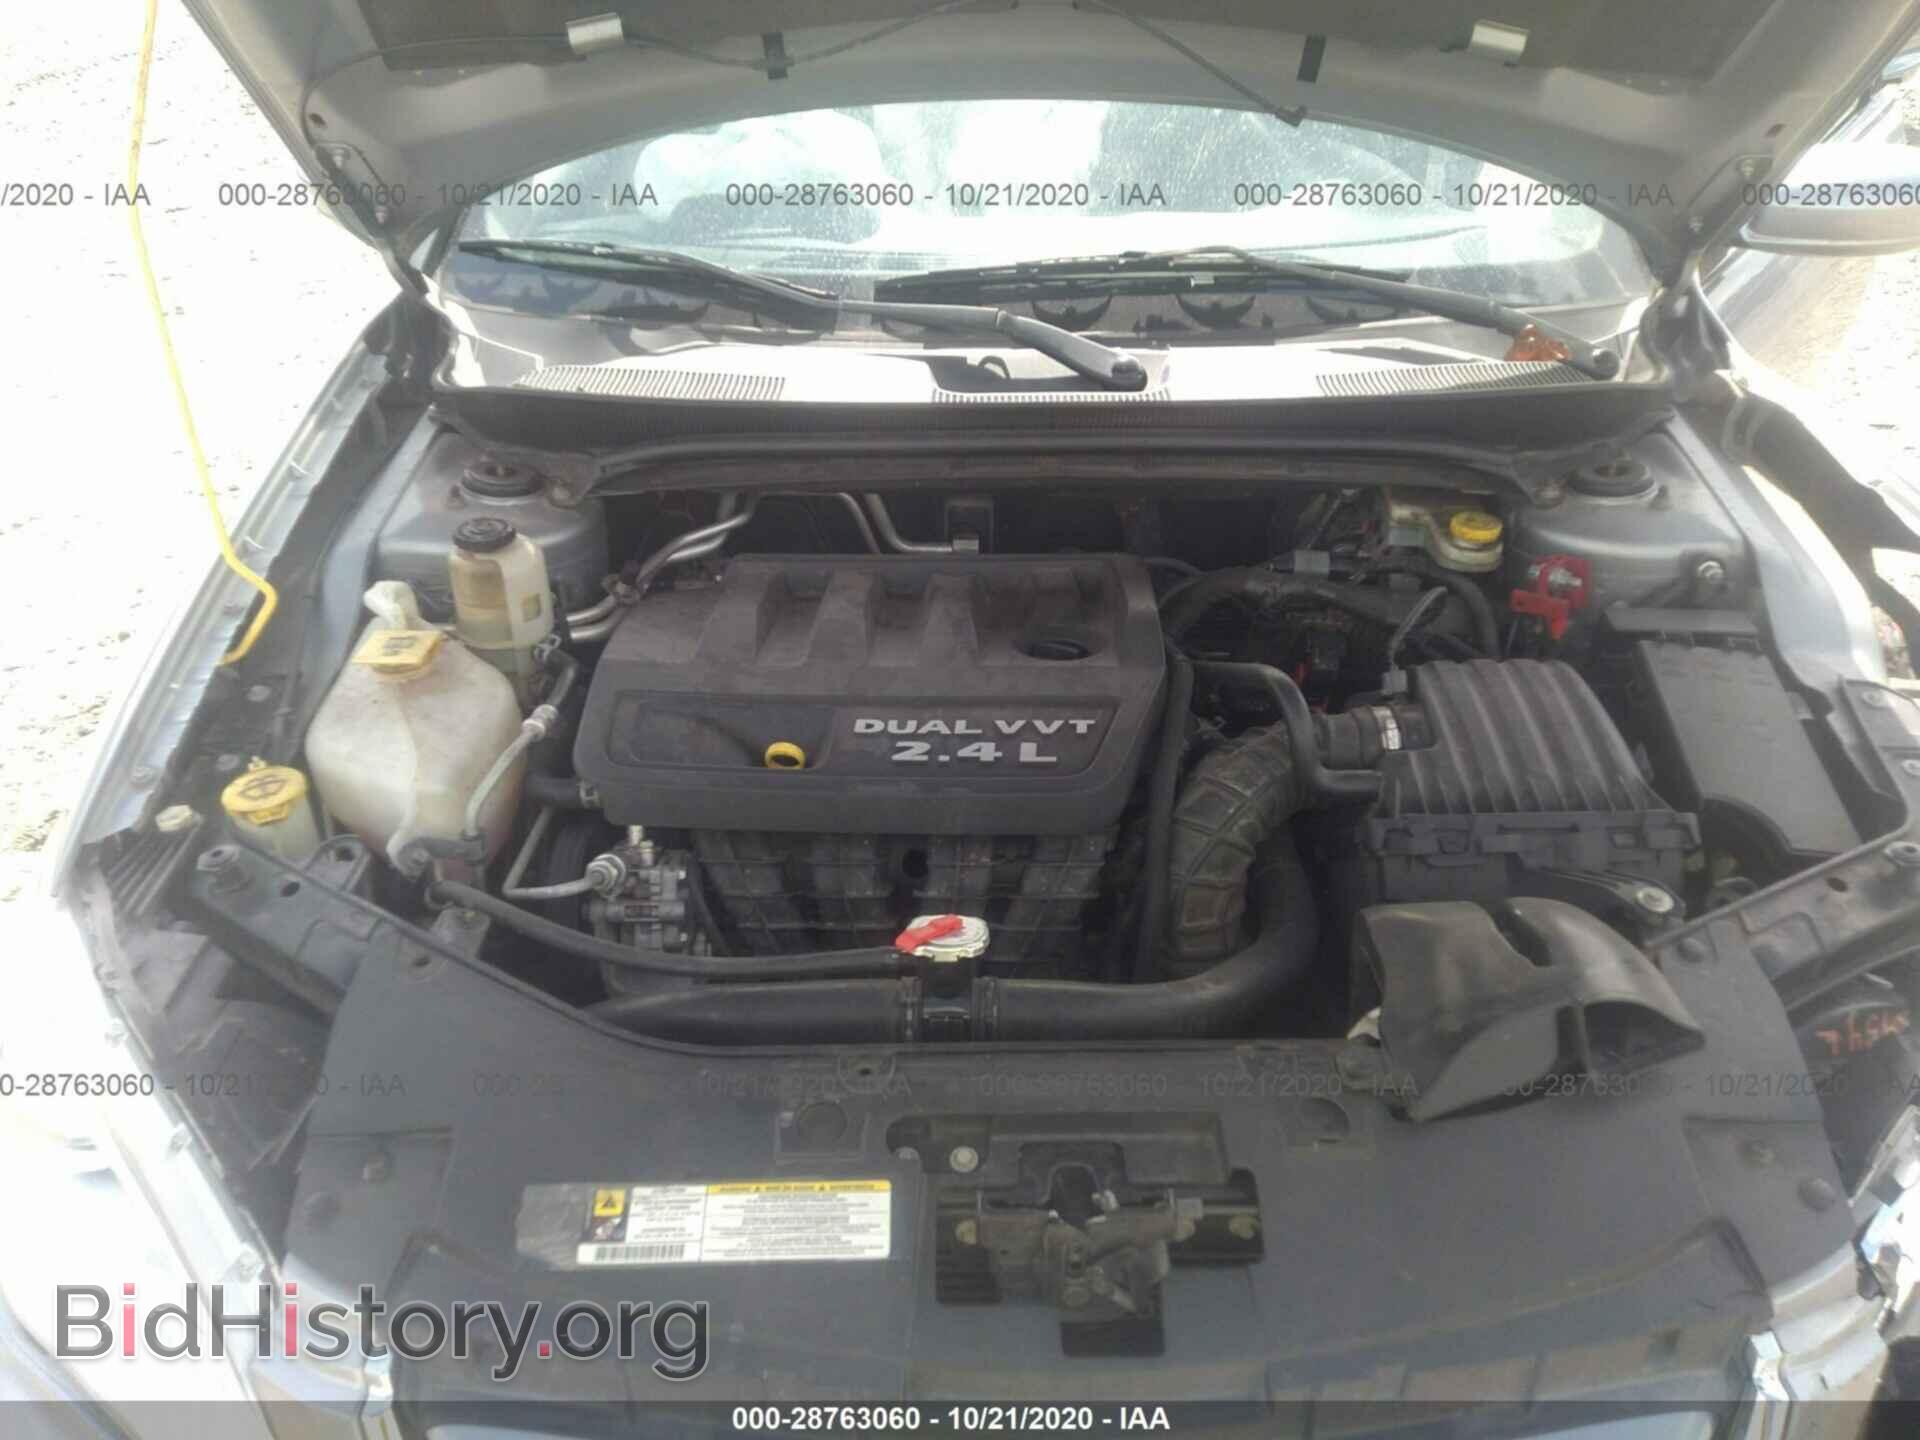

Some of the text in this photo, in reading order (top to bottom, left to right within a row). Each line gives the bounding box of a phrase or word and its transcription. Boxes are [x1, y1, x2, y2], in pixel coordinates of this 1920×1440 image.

[853, 718, 1096, 735] DUAL VVT
[891, 740, 1003, 763] 2.4
